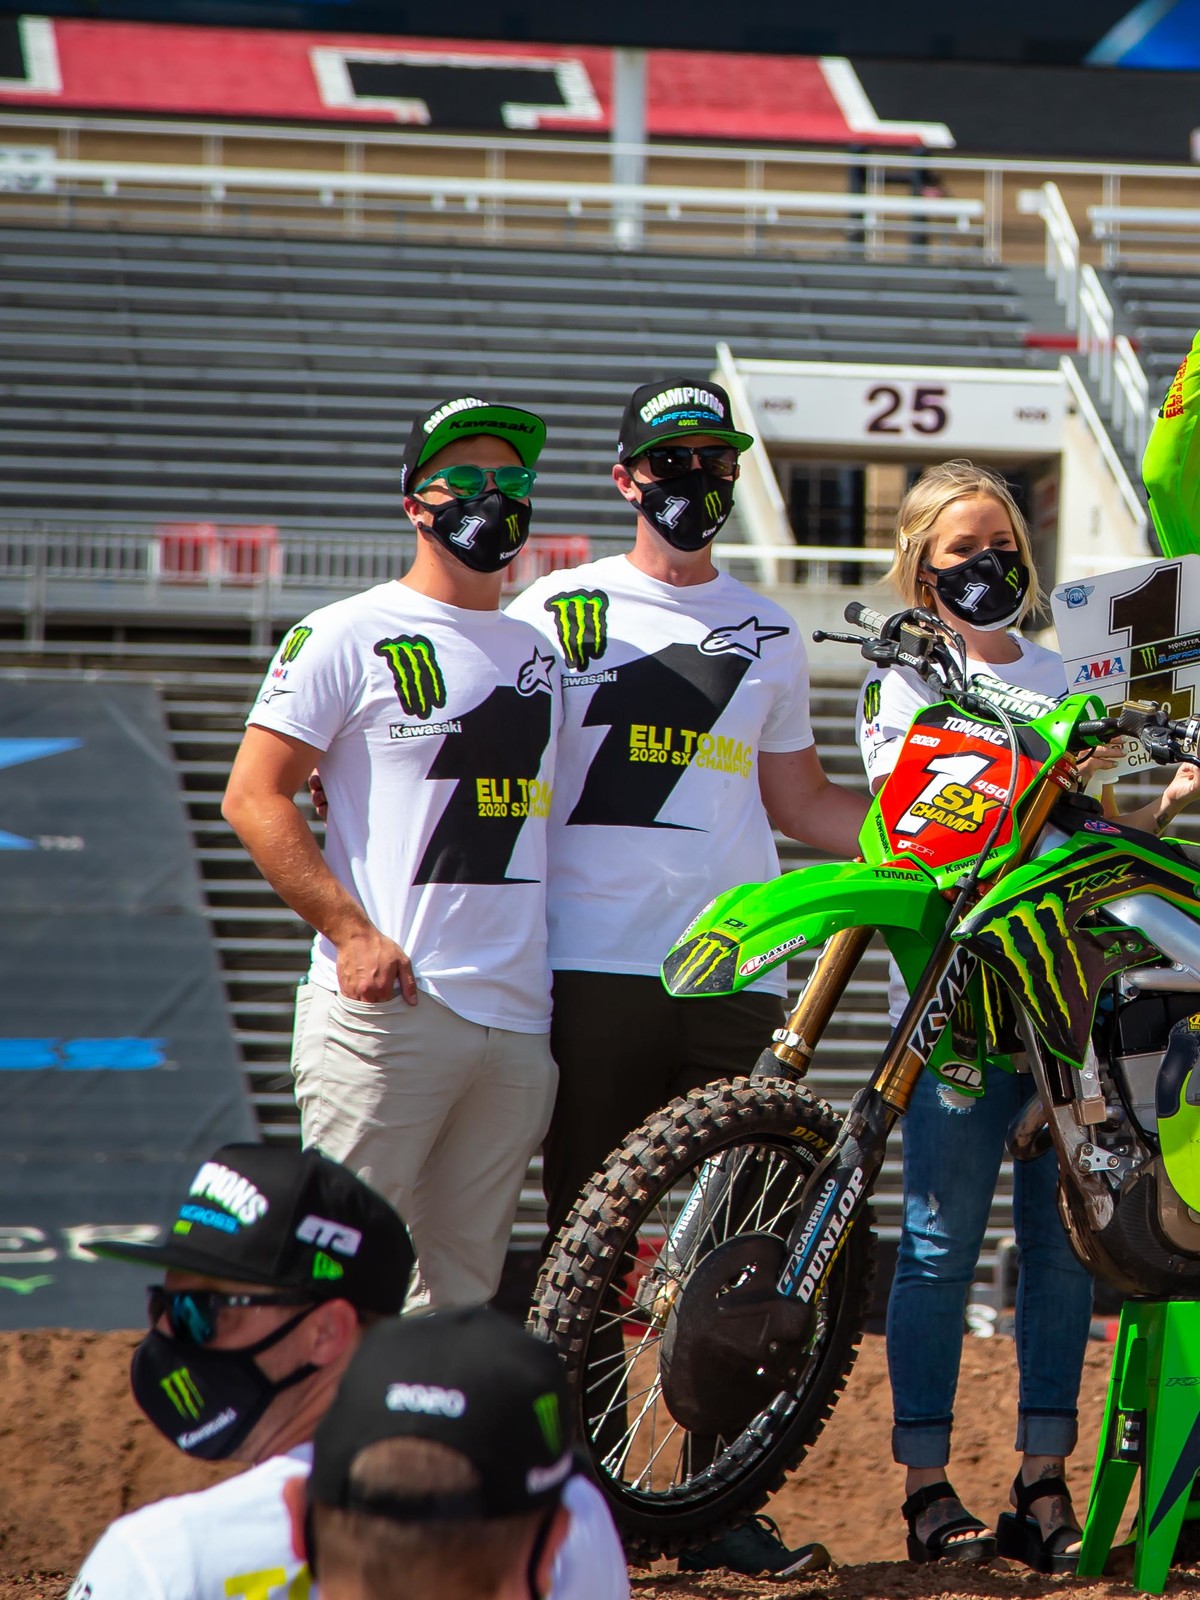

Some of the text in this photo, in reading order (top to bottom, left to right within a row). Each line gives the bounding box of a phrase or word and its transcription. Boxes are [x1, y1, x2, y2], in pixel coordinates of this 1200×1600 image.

[639, 386, 725, 424] CHAMPIONS
[651, 410, 722, 428] SUPERCROSS
[866, 385, 948, 434] 25
[449, 418, 537, 436] Kawasaki
[655, 495, 692, 530] 1
[450, 515, 487, 550] 1
[954, 582, 991, 613] 1
[1108, 562, 1196, 722] 1
[1168, 637, 1200, 650] MONSTER
[1072, 656, 1128, 685] AMA
[390, 720, 463, 739] Kawasaki
[629, 724, 753, 767] ELI TOMAC
[909, 734, 941, 748] 2020
[942, 716, 1008, 747] TOMAC
[629, 747, 668, 763] 2020
[671, 750, 691, 766] SX
[476, 778, 510, 803] ELI
[893, 752, 998, 838] 1
[932, 784, 1002, 822] SX
[974, 779, 1008, 800] 450
[478, 803, 507, 817] 2020
[511, 802, 529, 817] SX
[911, 802, 980, 834] CHAMP
[874, 814, 891, 854] Kawasaki
[872, 869, 925, 882] TOMAC
[1064, 861, 1135, 902] KX
[795, 1178, 836, 1255] CARRILLO
[796, 1166, 864, 1304] DUNLOP
[385, 1383, 466, 1419] 2020
